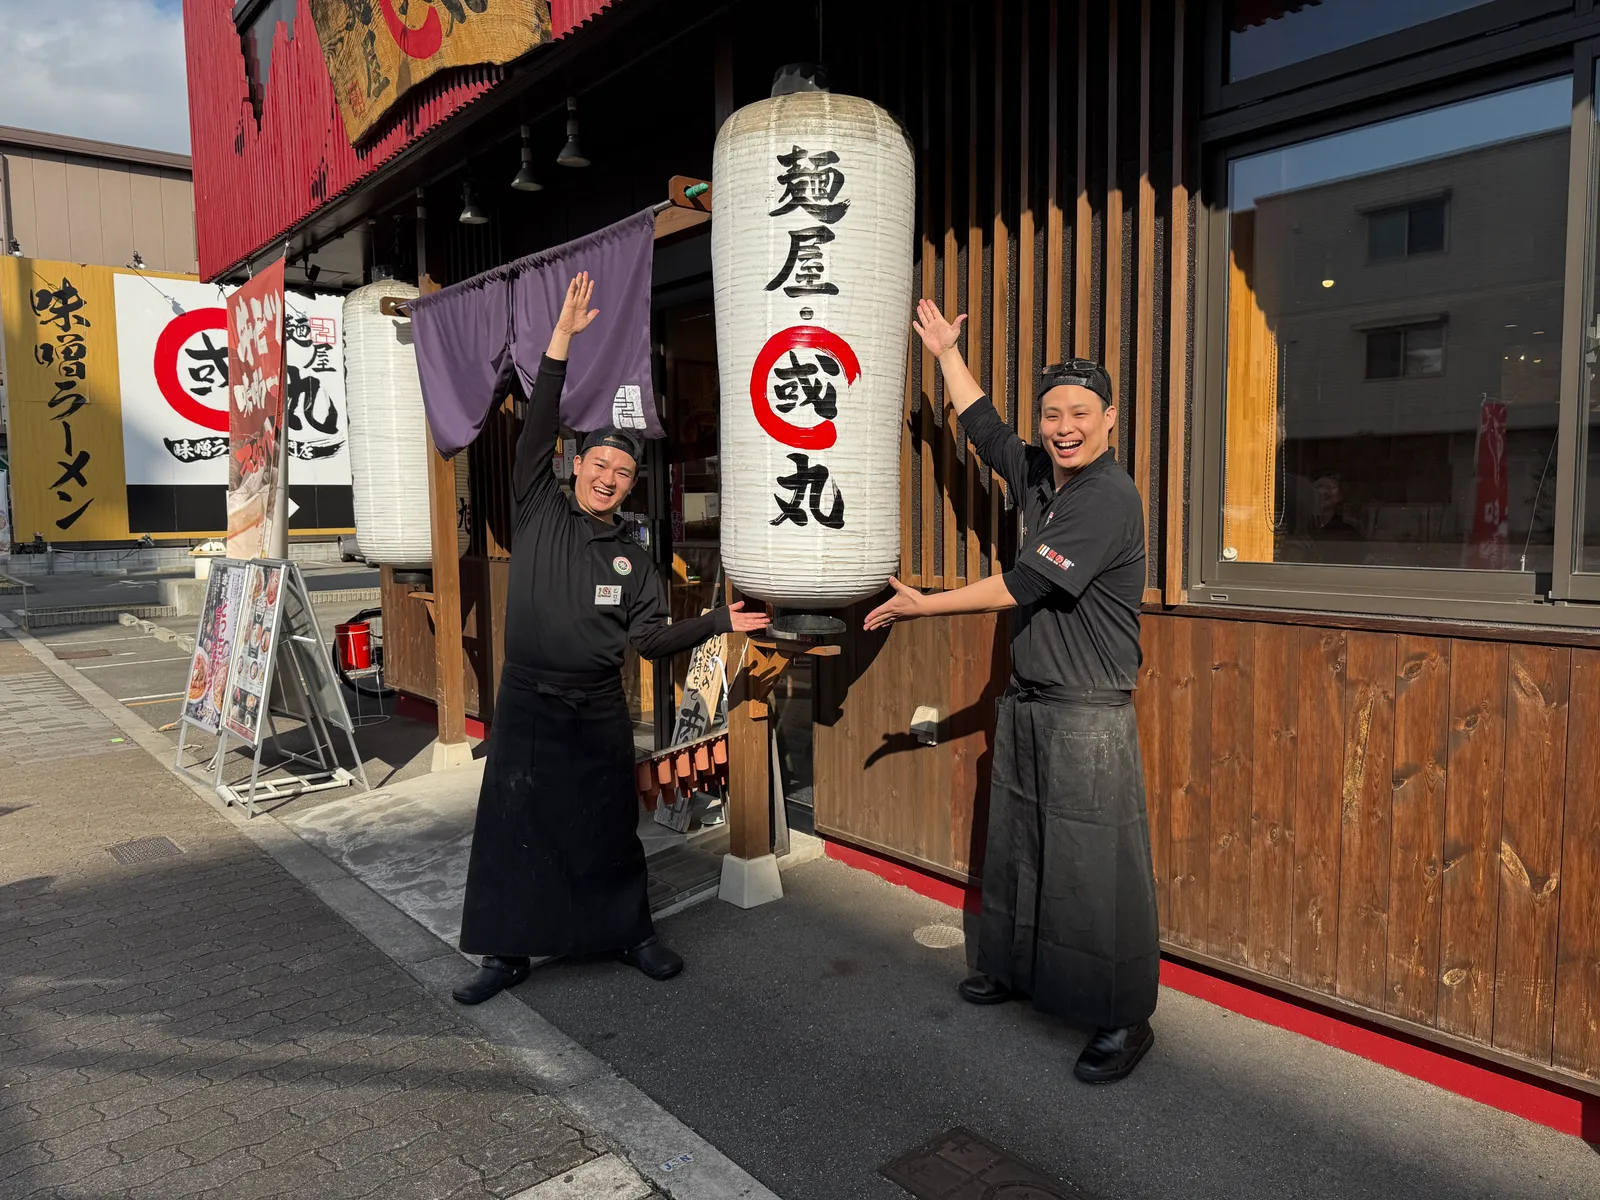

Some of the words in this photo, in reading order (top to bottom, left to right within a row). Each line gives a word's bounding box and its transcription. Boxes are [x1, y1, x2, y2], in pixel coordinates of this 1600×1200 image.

[29, 276, 95, 531] 味噌ラーメン
[172, 438, 229, 460] 味噌ラ
